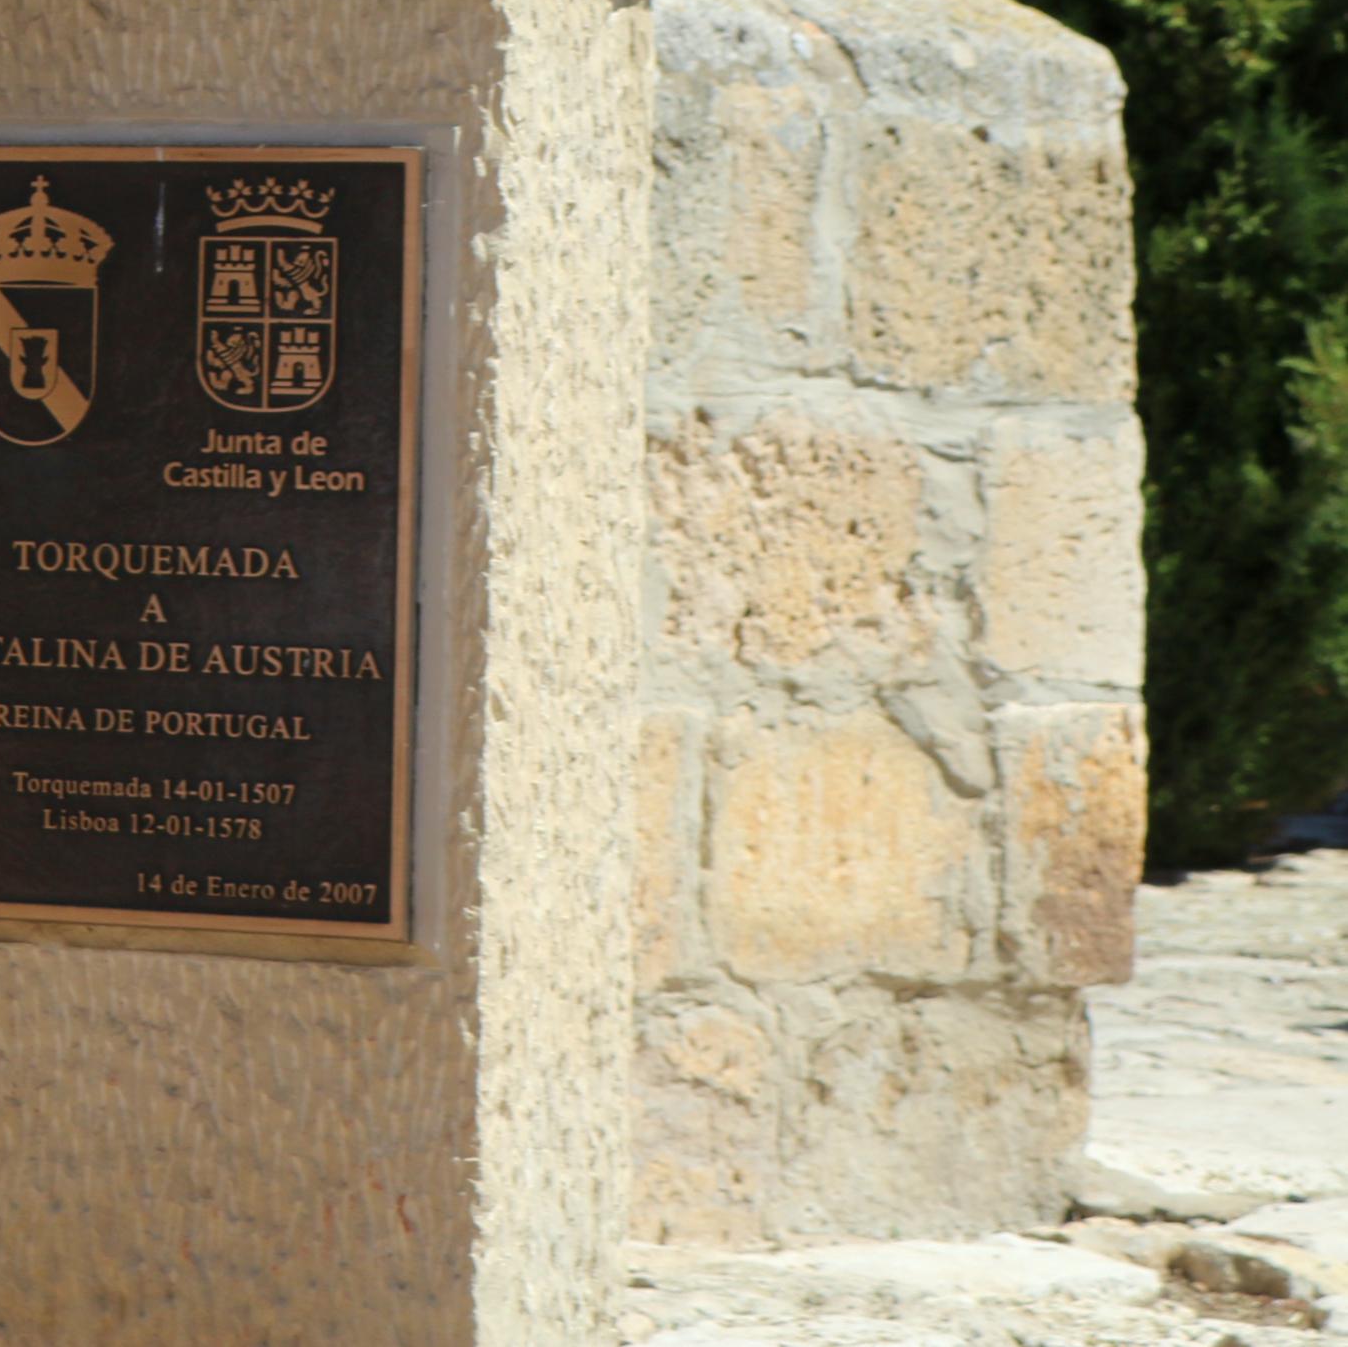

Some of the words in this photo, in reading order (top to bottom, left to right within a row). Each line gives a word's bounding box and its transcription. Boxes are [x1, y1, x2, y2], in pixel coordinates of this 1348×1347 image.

[200, 428, 282, 455] Junta
[290, 430, 328, 456] de
[163, 461, 263, 490] Castilla
[267, 470, 288, 498] y
[294, 465, 365, 492] Leon
[12, 540, 299, 581] TORQUEMADA
[139, 593, 167, 623] A
[138, 641, 190, 673] DE
[201, 644, 382, 680] AUSTRIA
[94, 707, 135, 733] DE
[145, 710, 311, 741] PORTUGAL
[11, 771, 153, 800] Torquemada
[162, 778, 296, 805] 14-01-1507
[43, 808, 120, 833] Lisboa
[130, 813, 262, 840] 12-01-1578
[137, 872, 162, 893] 14
[170, 873, 198, 896] de
[206, 875, 276, 900] Enero
[282, 879, 311, 902] de
[319, 881, 378, 905] 2007
